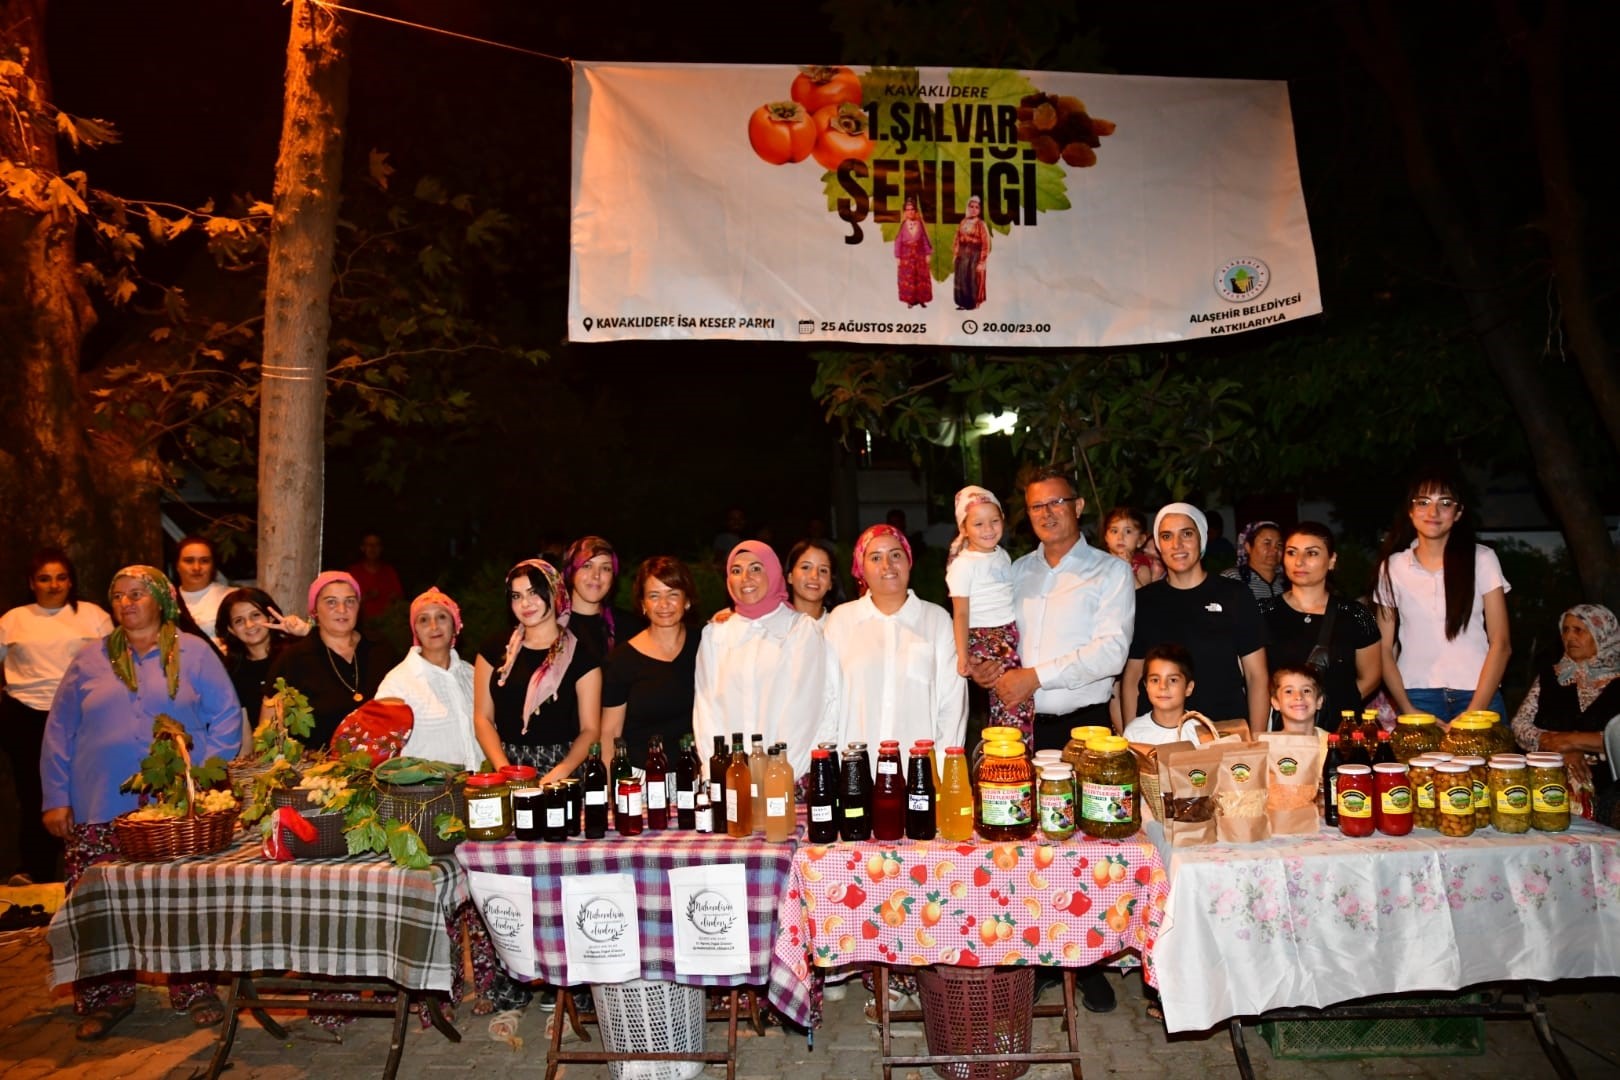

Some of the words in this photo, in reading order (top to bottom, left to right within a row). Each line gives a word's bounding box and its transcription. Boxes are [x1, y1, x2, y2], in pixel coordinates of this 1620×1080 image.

[884, 84, 990, 99] KAVAKLIDERE
[863, 101, 1018, 154] 1.ŞALVAR
[836, 144, 1037, 245] ŞENLİĞİ
[1190, 308, 1240, 323] ALAŞEHİR
[1243, 292, 1301, 316] BELEDİYESİ
[596, 316, 675, 328] KAVAKLIDERE
[678, 314, 697, 328] İSA
[700, 317, 736, 328] KESER
[739, 318, 775, 329] PARKI
[821, 322, 836, 331] 25
[838, 319, 893, 333] AĞUSTOS
[896, 323, 927, 333] 2025
[982, 322, 1051, 333] 20.00/23.00
[1210, 313, 1286, 334] KATKILARIYLA
